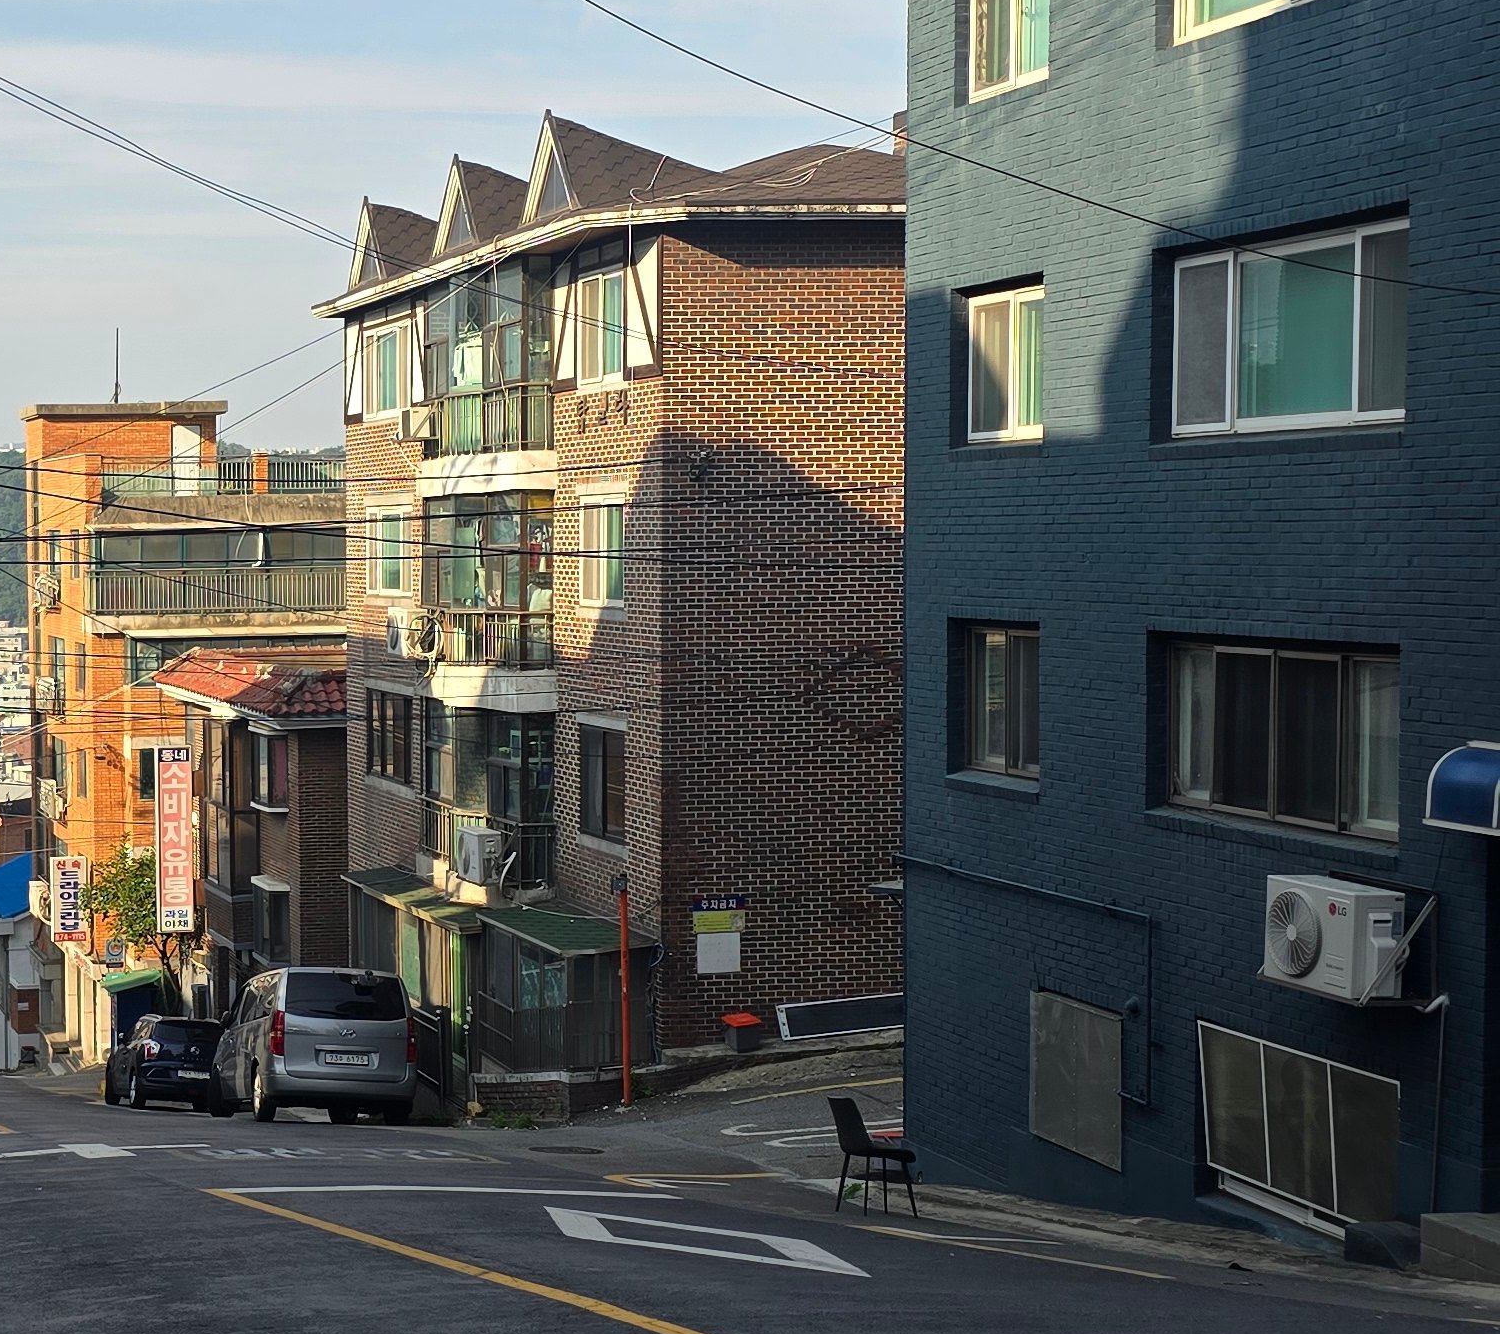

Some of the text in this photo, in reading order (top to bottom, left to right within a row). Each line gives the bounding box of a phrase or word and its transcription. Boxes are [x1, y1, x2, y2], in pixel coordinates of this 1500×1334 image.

[160, 749, 187, 762] 동네
[161, 763, 190, 903] 소비자유통
[701, 898, 737, 909] 주차금지
[164, 909, 188, 918] 과일
[1337, 905, 1347, 917] LG
